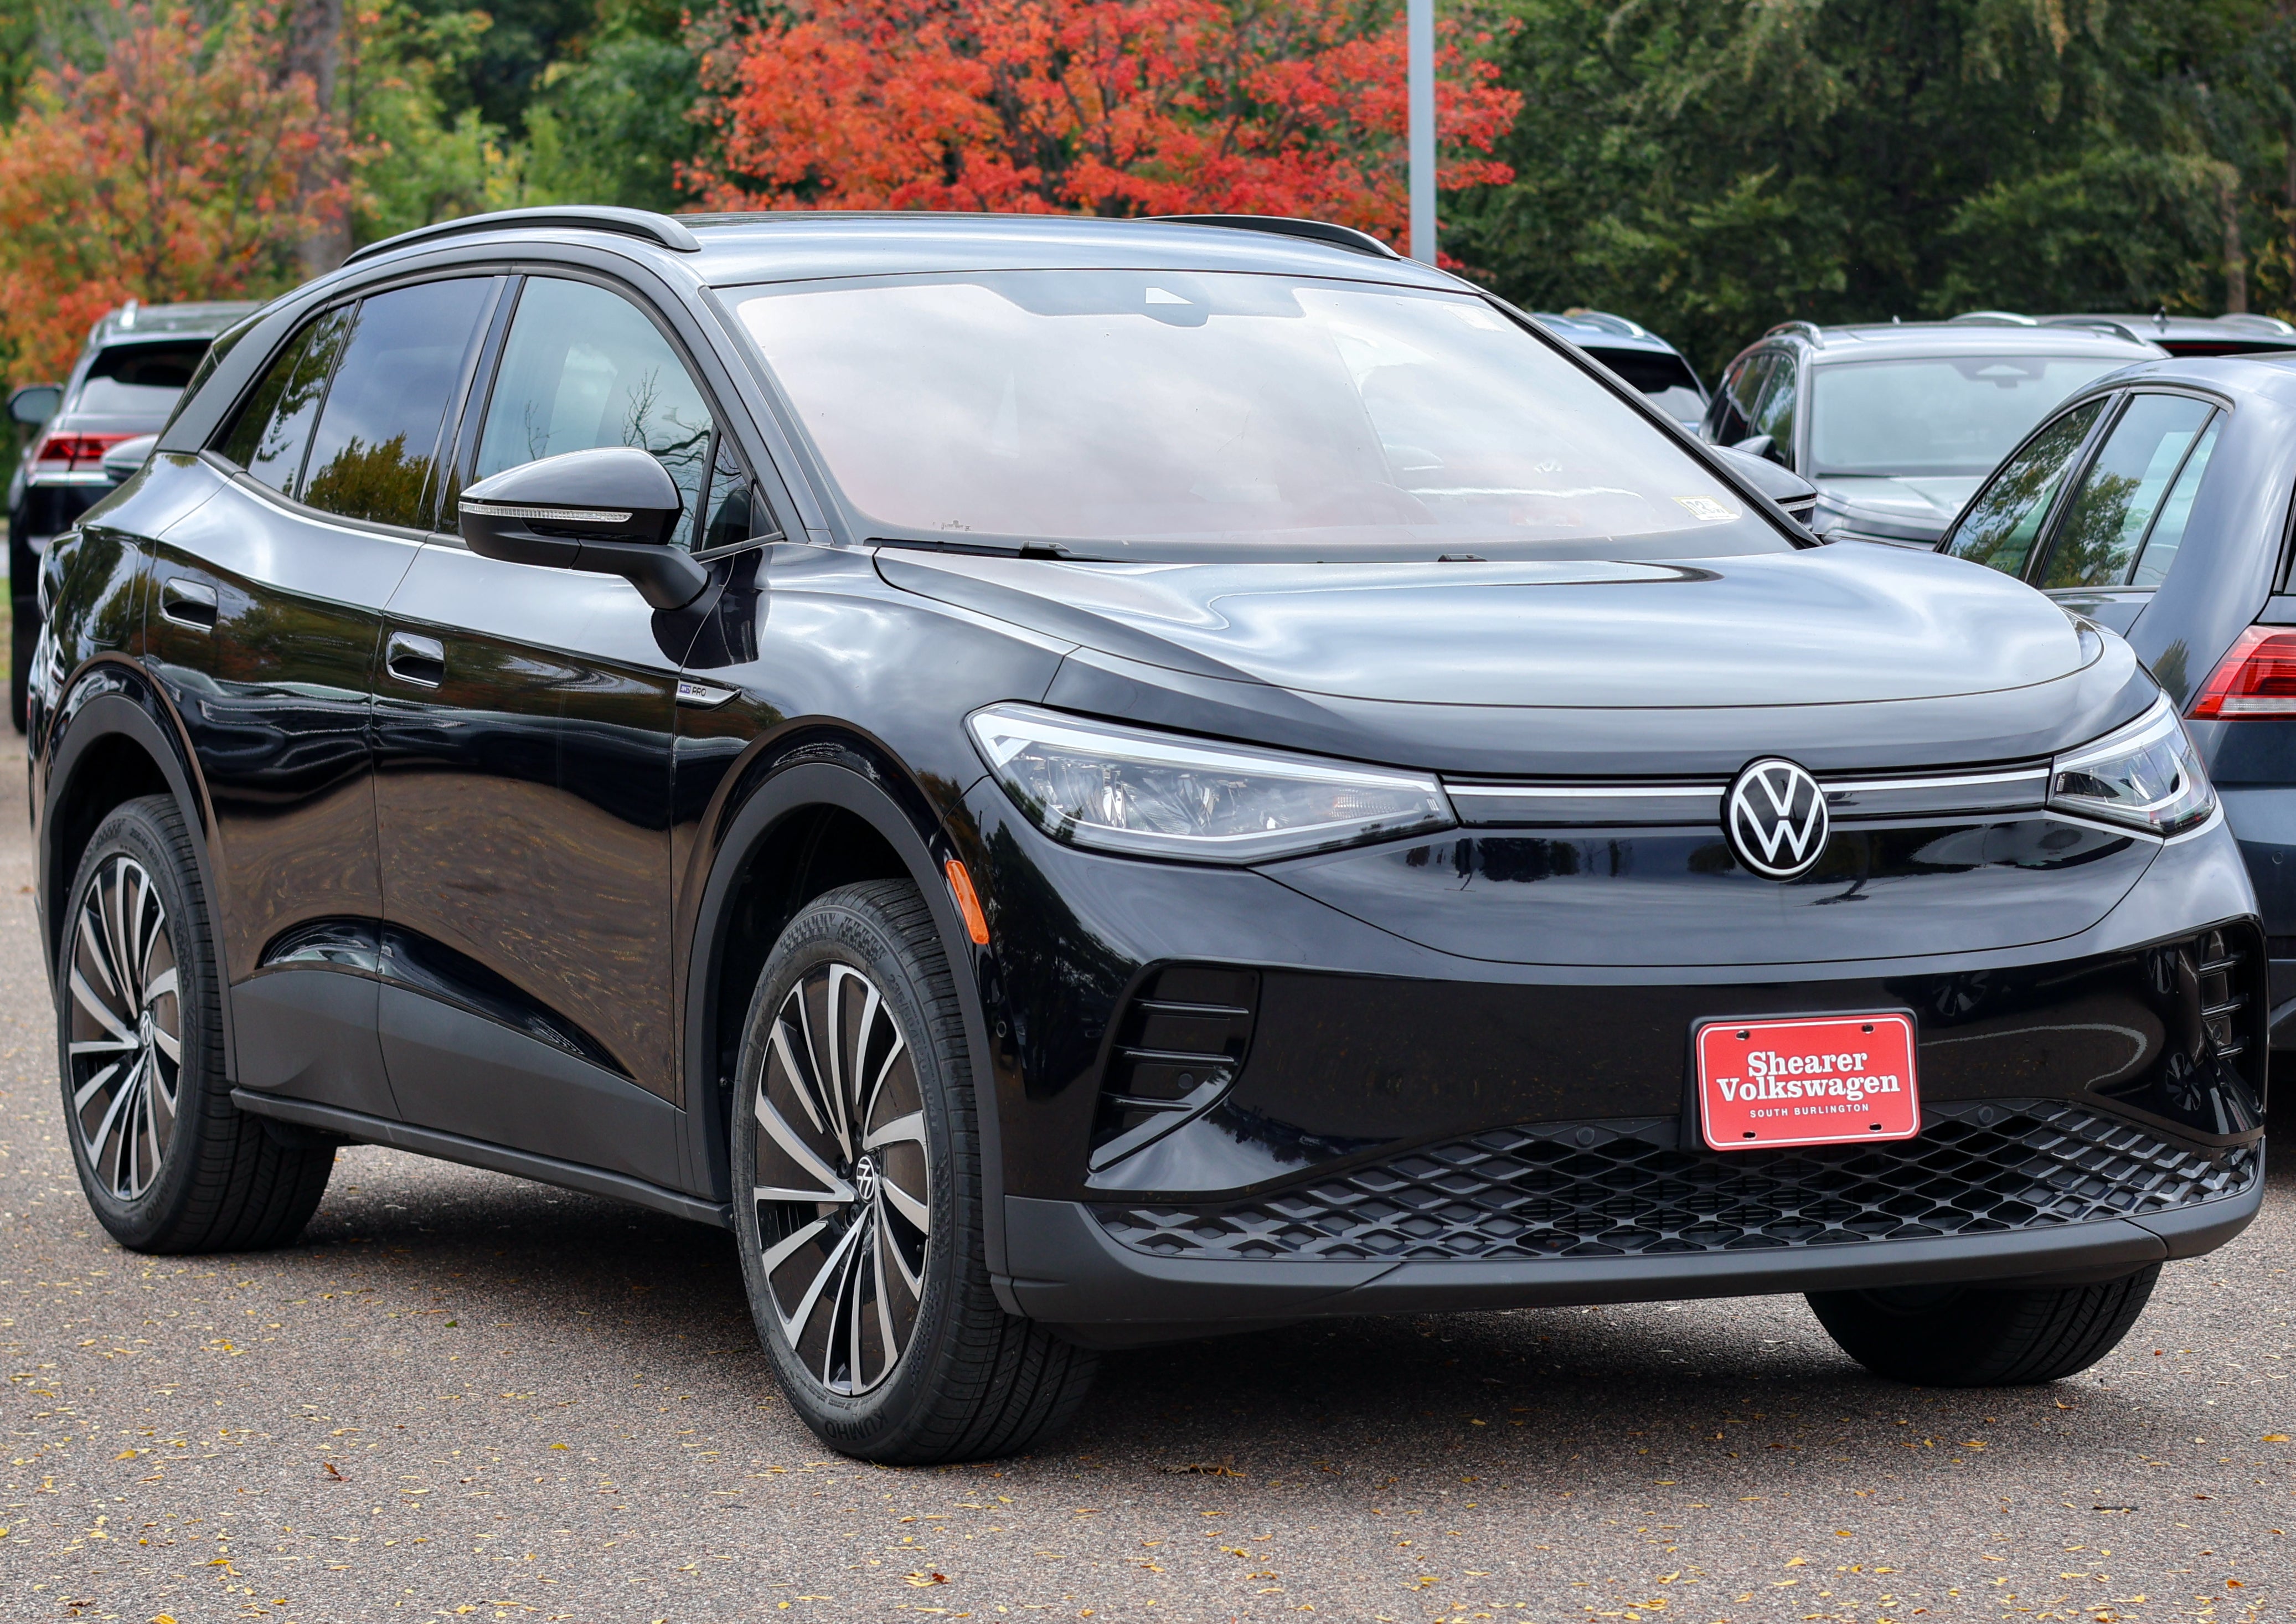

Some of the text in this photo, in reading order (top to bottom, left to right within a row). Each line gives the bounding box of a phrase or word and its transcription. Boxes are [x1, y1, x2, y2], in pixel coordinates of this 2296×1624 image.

[692, 687, 706, 697] PRO
[1735, 765, 1825, 867] VW
[1747, 1051, 1868, 1077] Shearer
[1716, 1074, 1901, 1101] Volkswagen
[1750, 1103, 1869, 1118] SOUTH BURLINGTON
[824, 1407, 888, 1440] KUMHO
